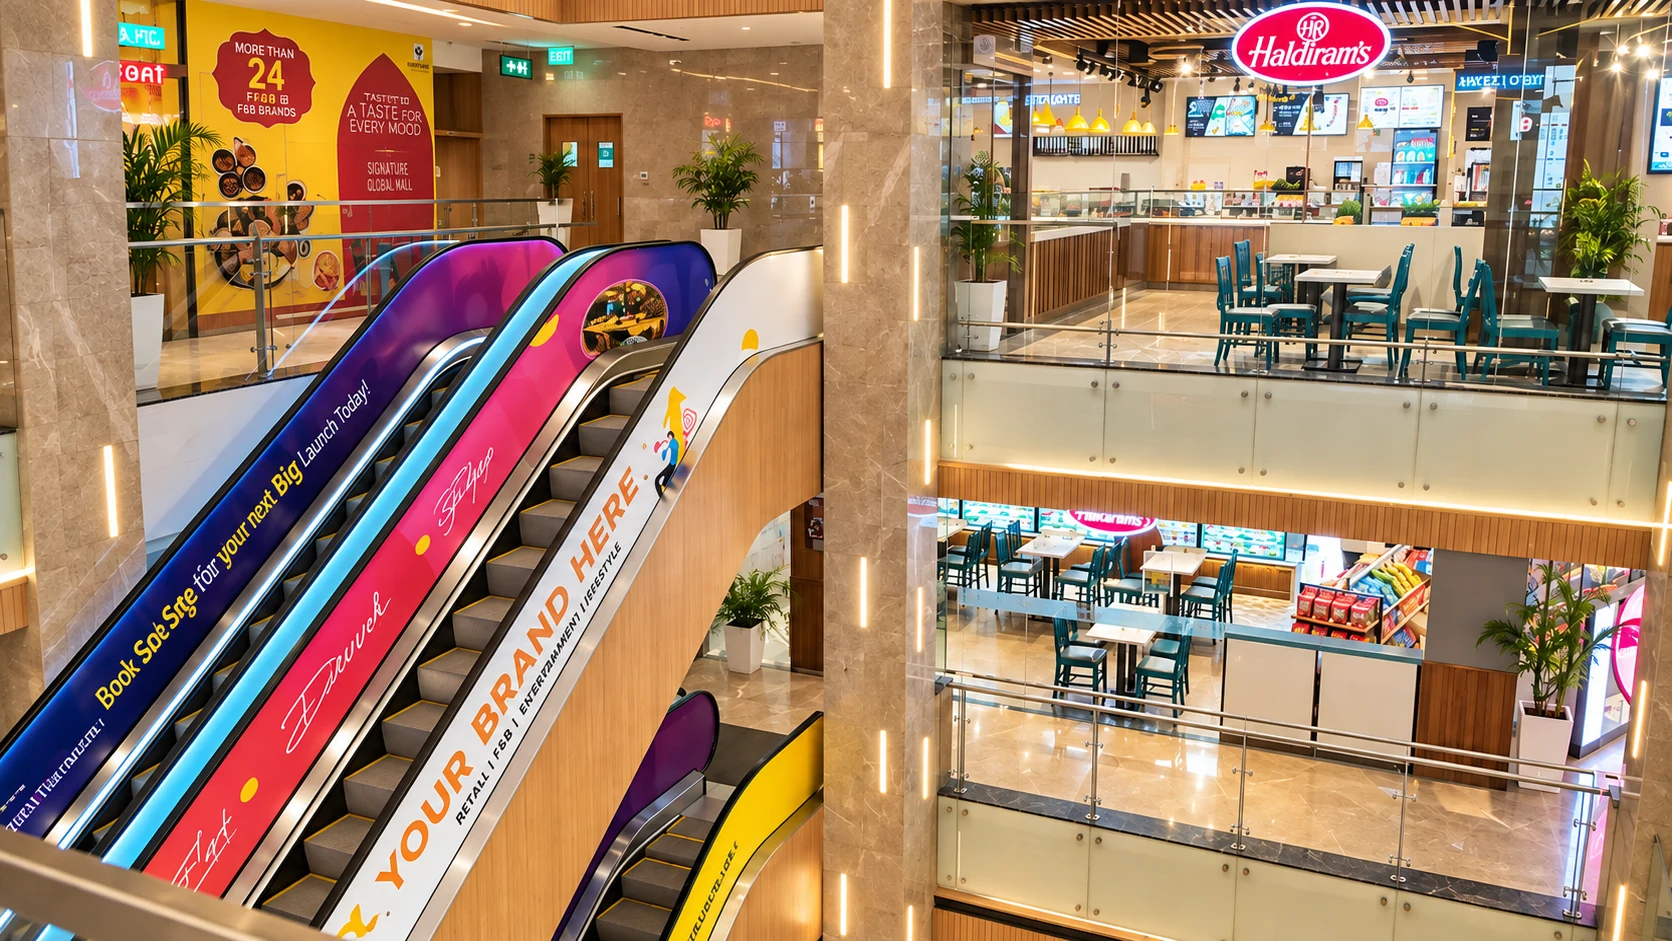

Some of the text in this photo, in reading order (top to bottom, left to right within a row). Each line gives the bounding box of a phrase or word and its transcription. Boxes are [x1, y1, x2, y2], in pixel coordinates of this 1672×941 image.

[235, 42, 295, 59] MORE THAN
[1248, 36, 1373, 68] Haldiram's
[248, 57, 285, 91] 24
[258, 105, 297, 118] BRANDS
[346, 102, 423, 123] A TASTE FOR
[349, 118, 422, 136] EVERY MOOD
[367, 161, 409, 176] SIGNATURE
[94, 659, 141, 711] Book
[216, 521, 251, 570] your
[246, 489, 278, 529] next
[270, 459, 304, 497] Big
[296, 419, 339, 468] Launch
[333, 378, 371, 424] Today!
[374, 465, 640, 890] YOUR BRAND HERE
